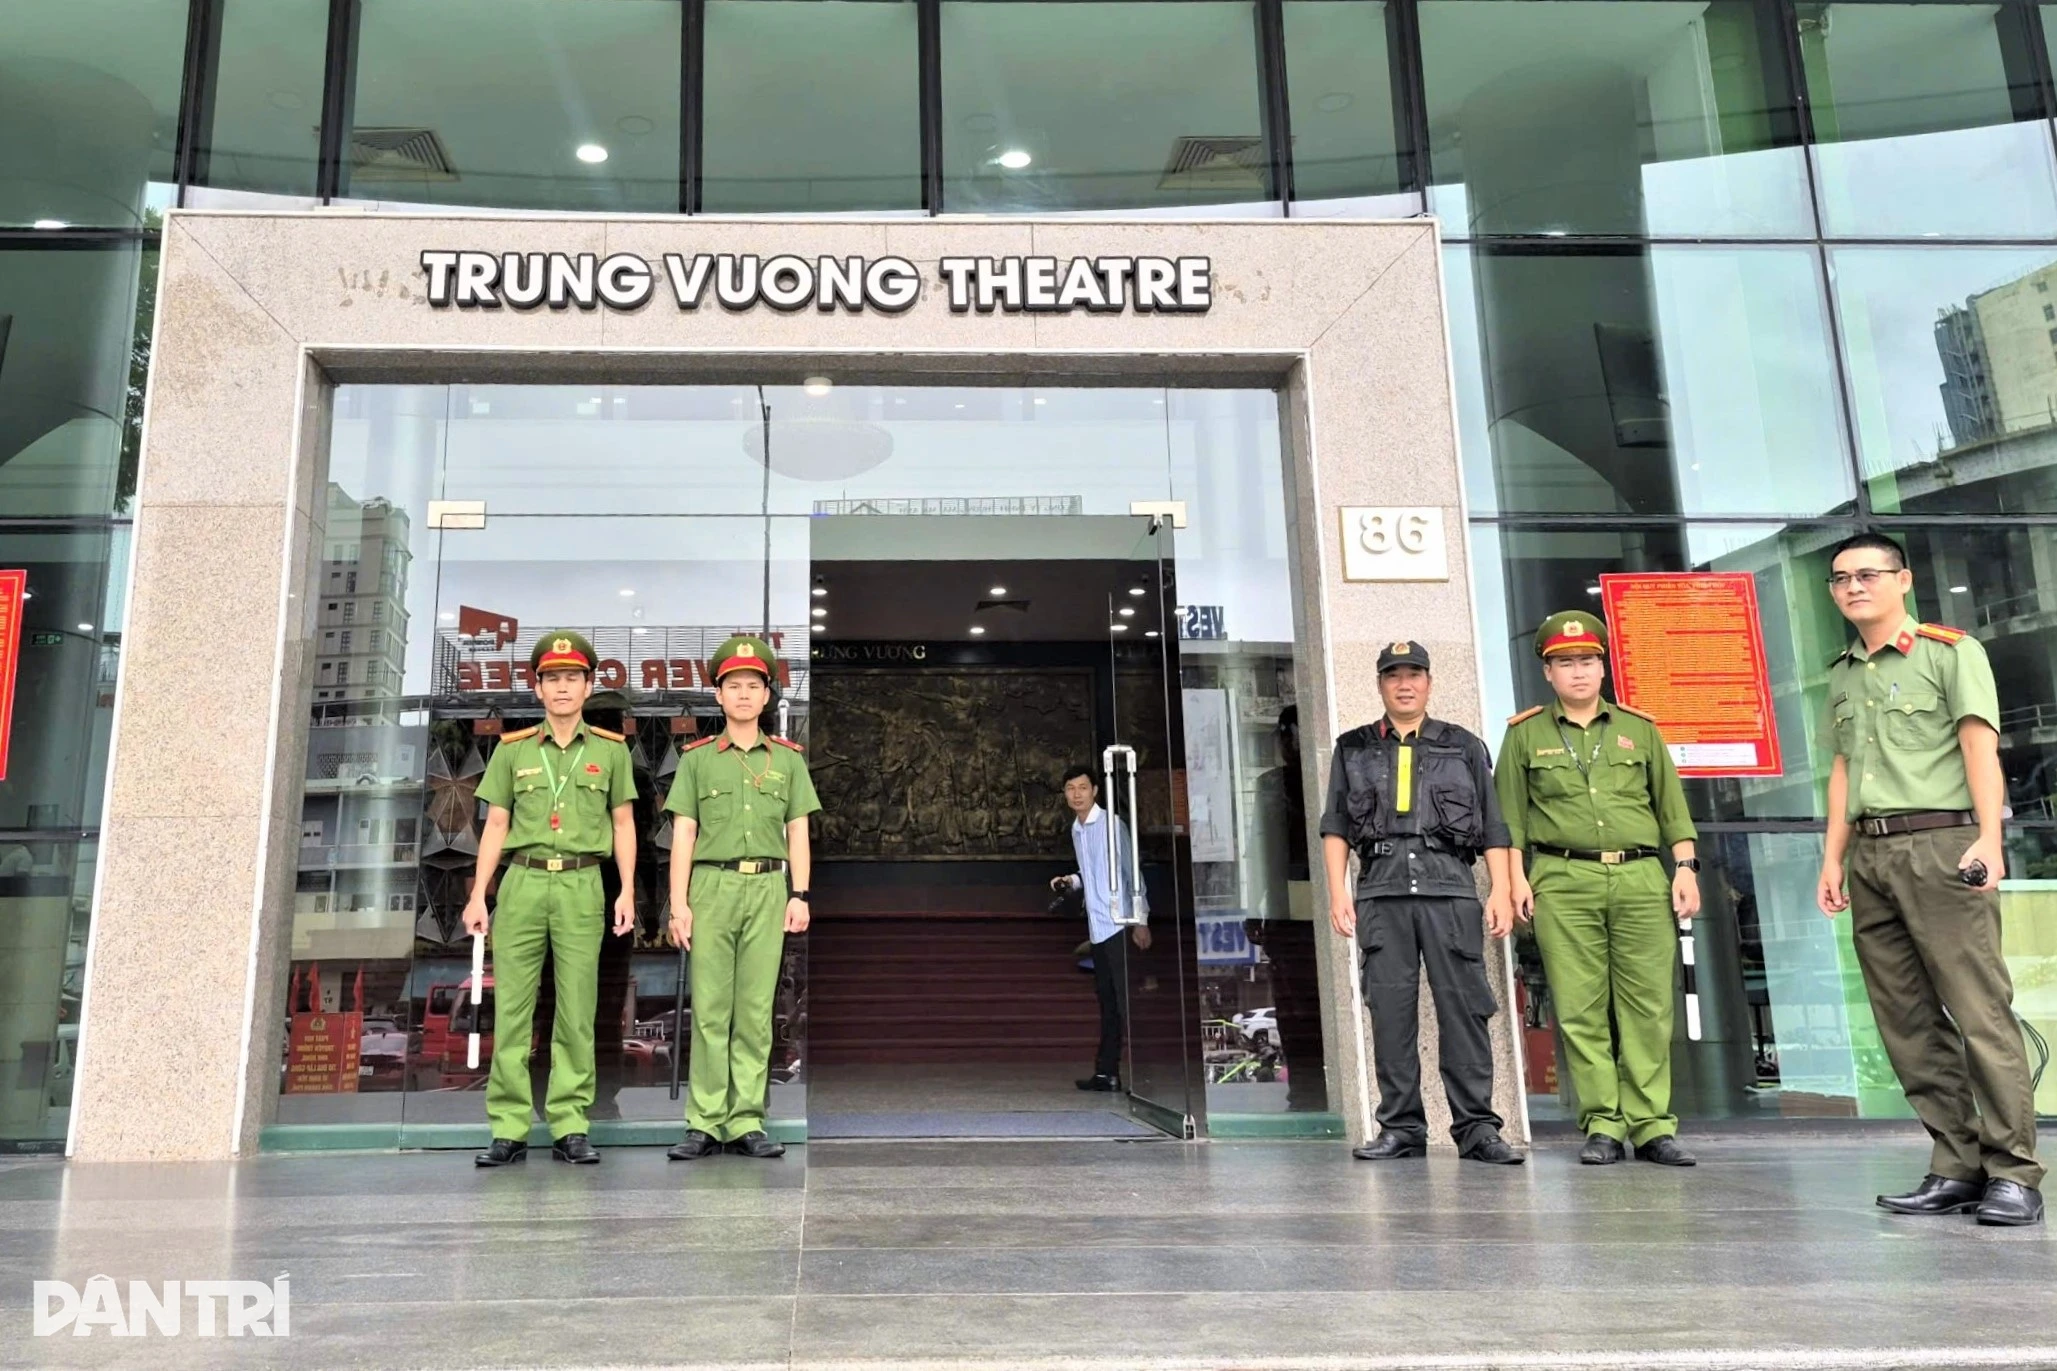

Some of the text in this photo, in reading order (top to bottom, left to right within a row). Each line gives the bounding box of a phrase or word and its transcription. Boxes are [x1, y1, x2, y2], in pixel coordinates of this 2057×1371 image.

[420, 250, 1211, 313] TRUNG VUONG THEATRE
[1359, 511, 1428, 555] 86
